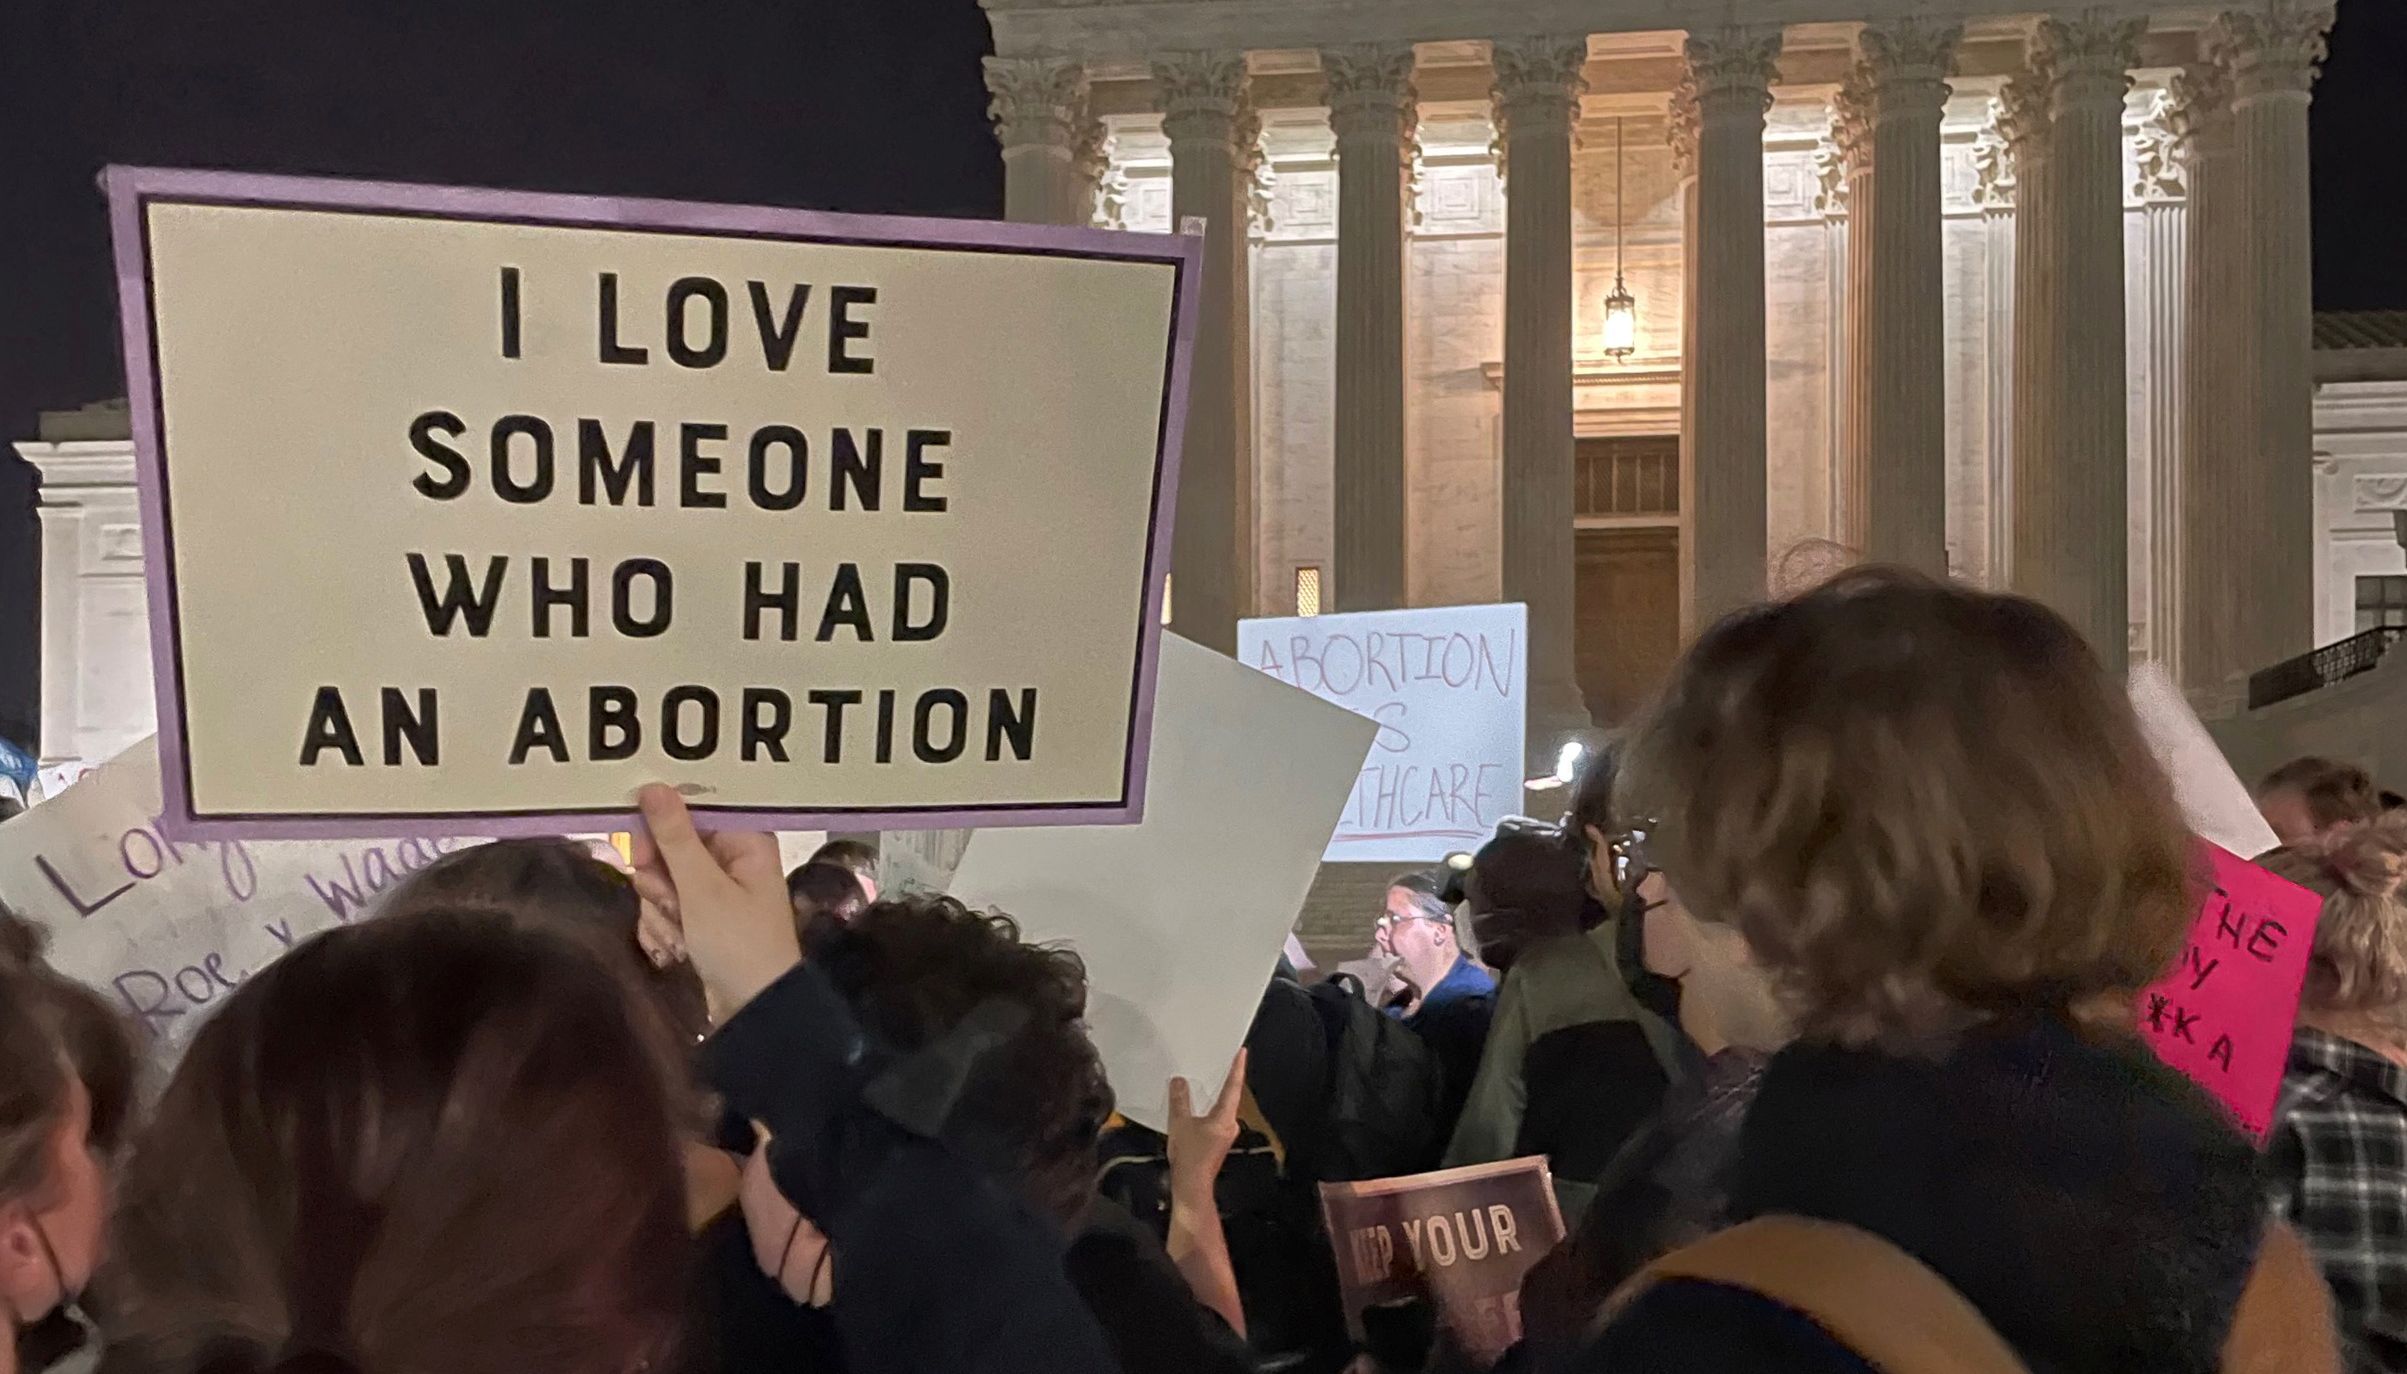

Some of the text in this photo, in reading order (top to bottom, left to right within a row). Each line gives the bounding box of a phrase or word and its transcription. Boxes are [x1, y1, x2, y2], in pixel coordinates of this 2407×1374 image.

[501, 267, 877, 374] I LOVE
[409, 411, 951, 513] SOMEONE
[406, 553, 950, 642] WHO HAD
[1260, 629, 1514, 697] ABORTION
[299, 685, 1037, 766] AN ABORTION
[1353, 702, 1411, 753] S
[1339, 763, 1502, 829] THCARE
[2213, 886, 2288, 963] HE
[112, 952, 240, 1037] Roe
[1402, 1204, 1522, 1272] YOUR
